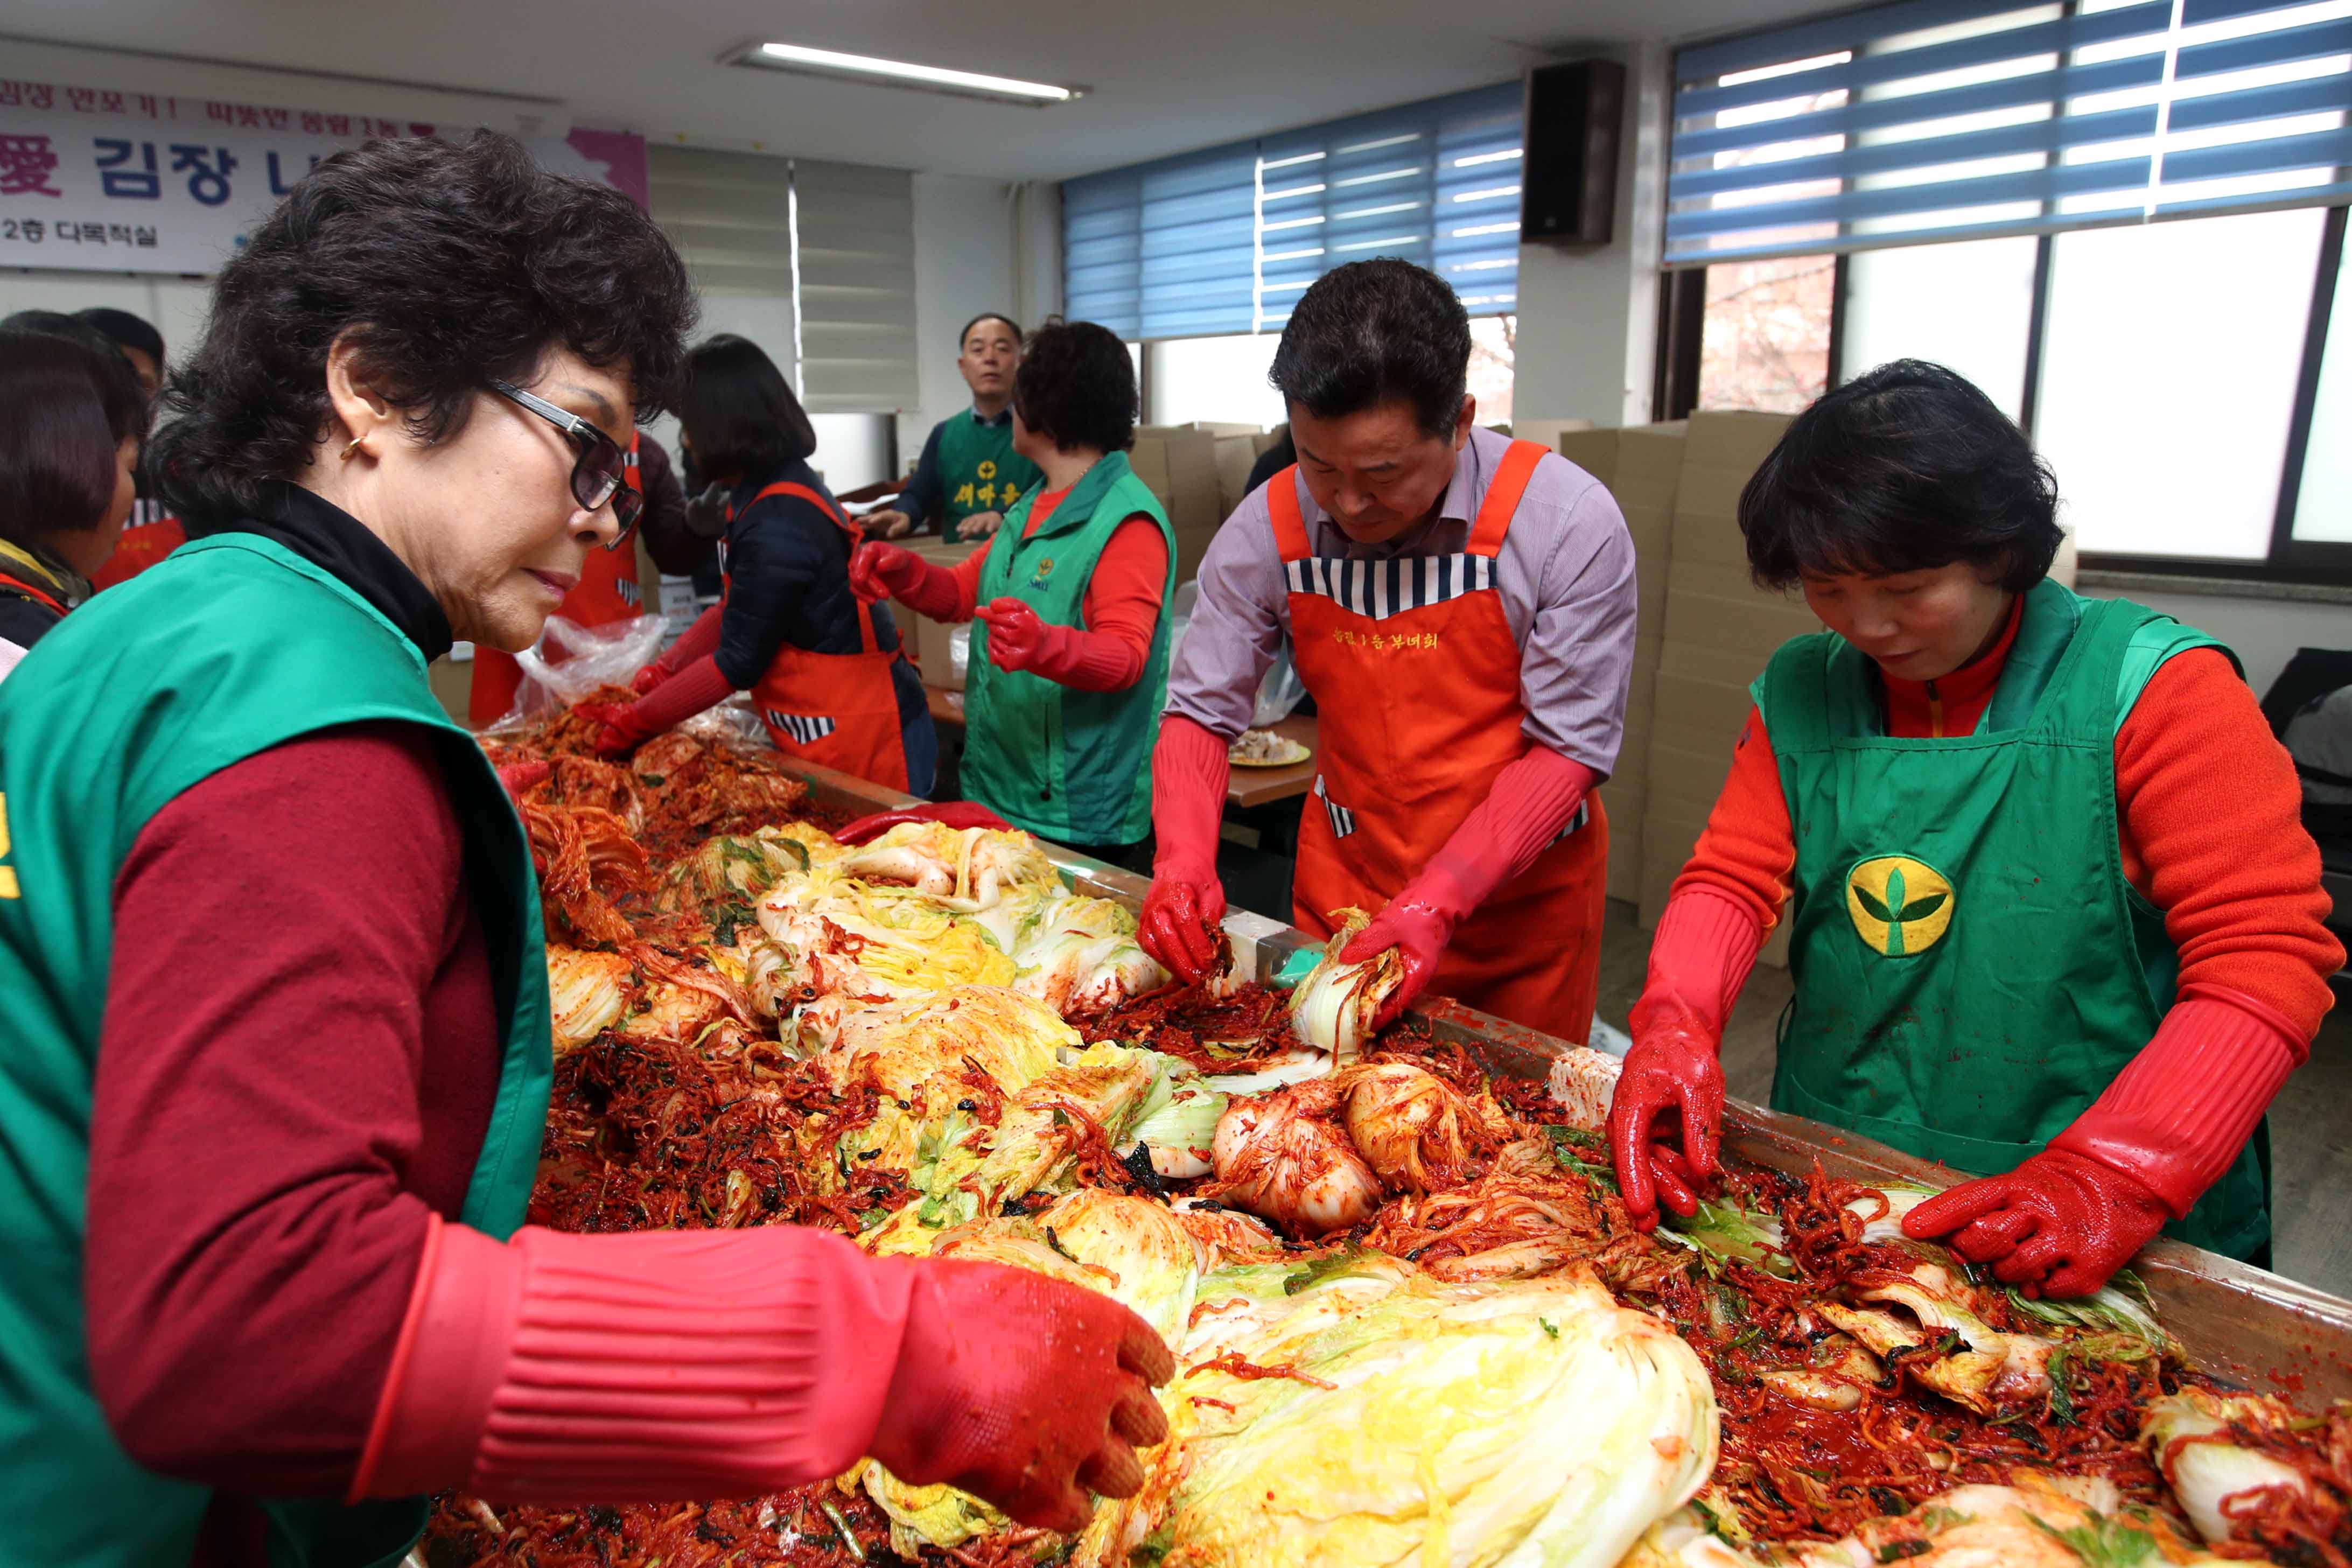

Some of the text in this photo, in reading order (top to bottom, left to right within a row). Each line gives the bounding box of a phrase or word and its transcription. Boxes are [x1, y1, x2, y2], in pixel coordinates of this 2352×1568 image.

[93, 137, 239, 206] 김장
[3, 220, 158, 249] 2층 다목적실
[953, 482, 1021, 508] 새마을
[1389, 633, 1438, 650] 부녀회
